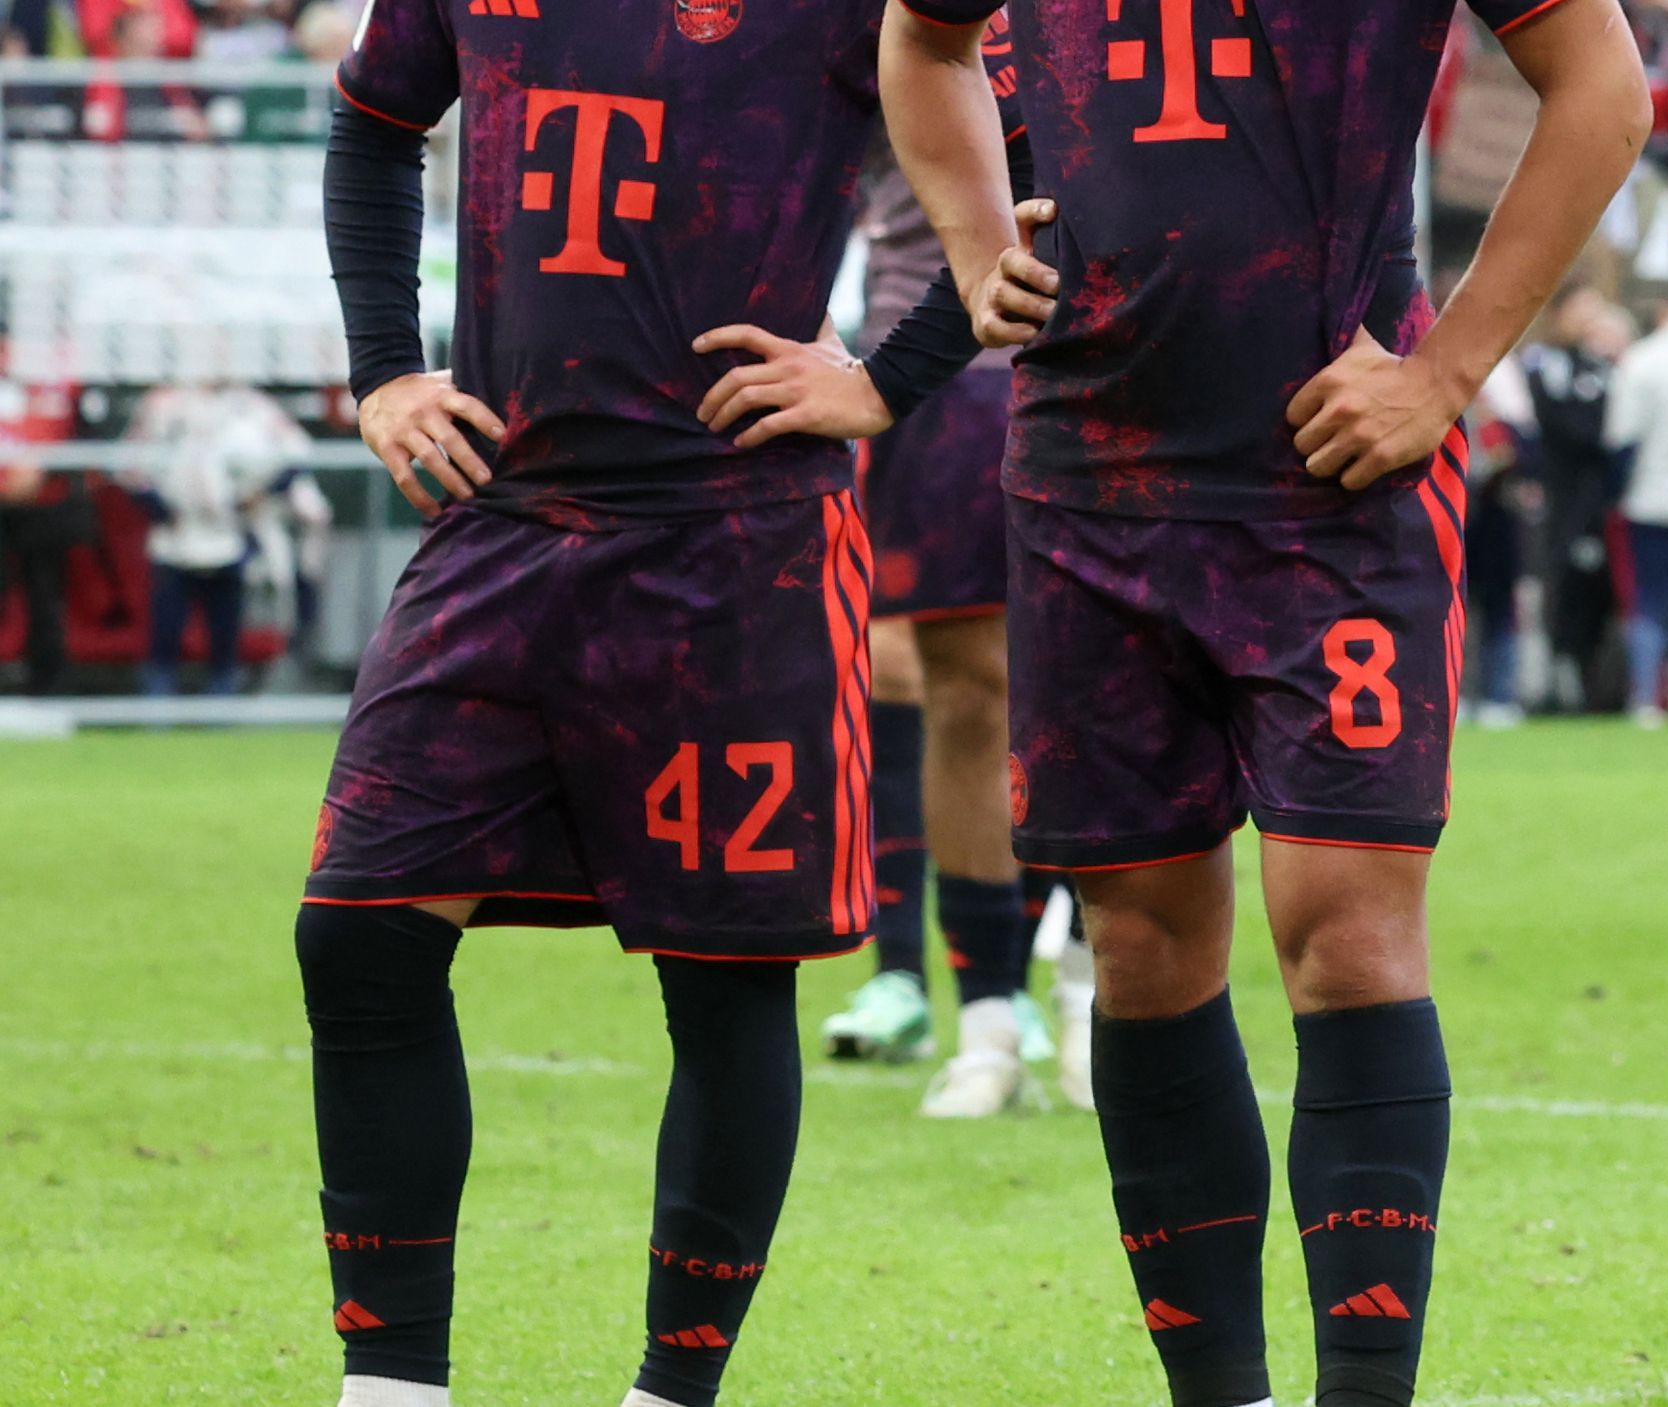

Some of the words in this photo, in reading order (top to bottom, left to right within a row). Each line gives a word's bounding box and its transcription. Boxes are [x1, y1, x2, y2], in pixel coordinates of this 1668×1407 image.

[521, 88, 665, 276] T
[1322, 618, 1401, 749] 8
[644, 741, 796, 873] 42
